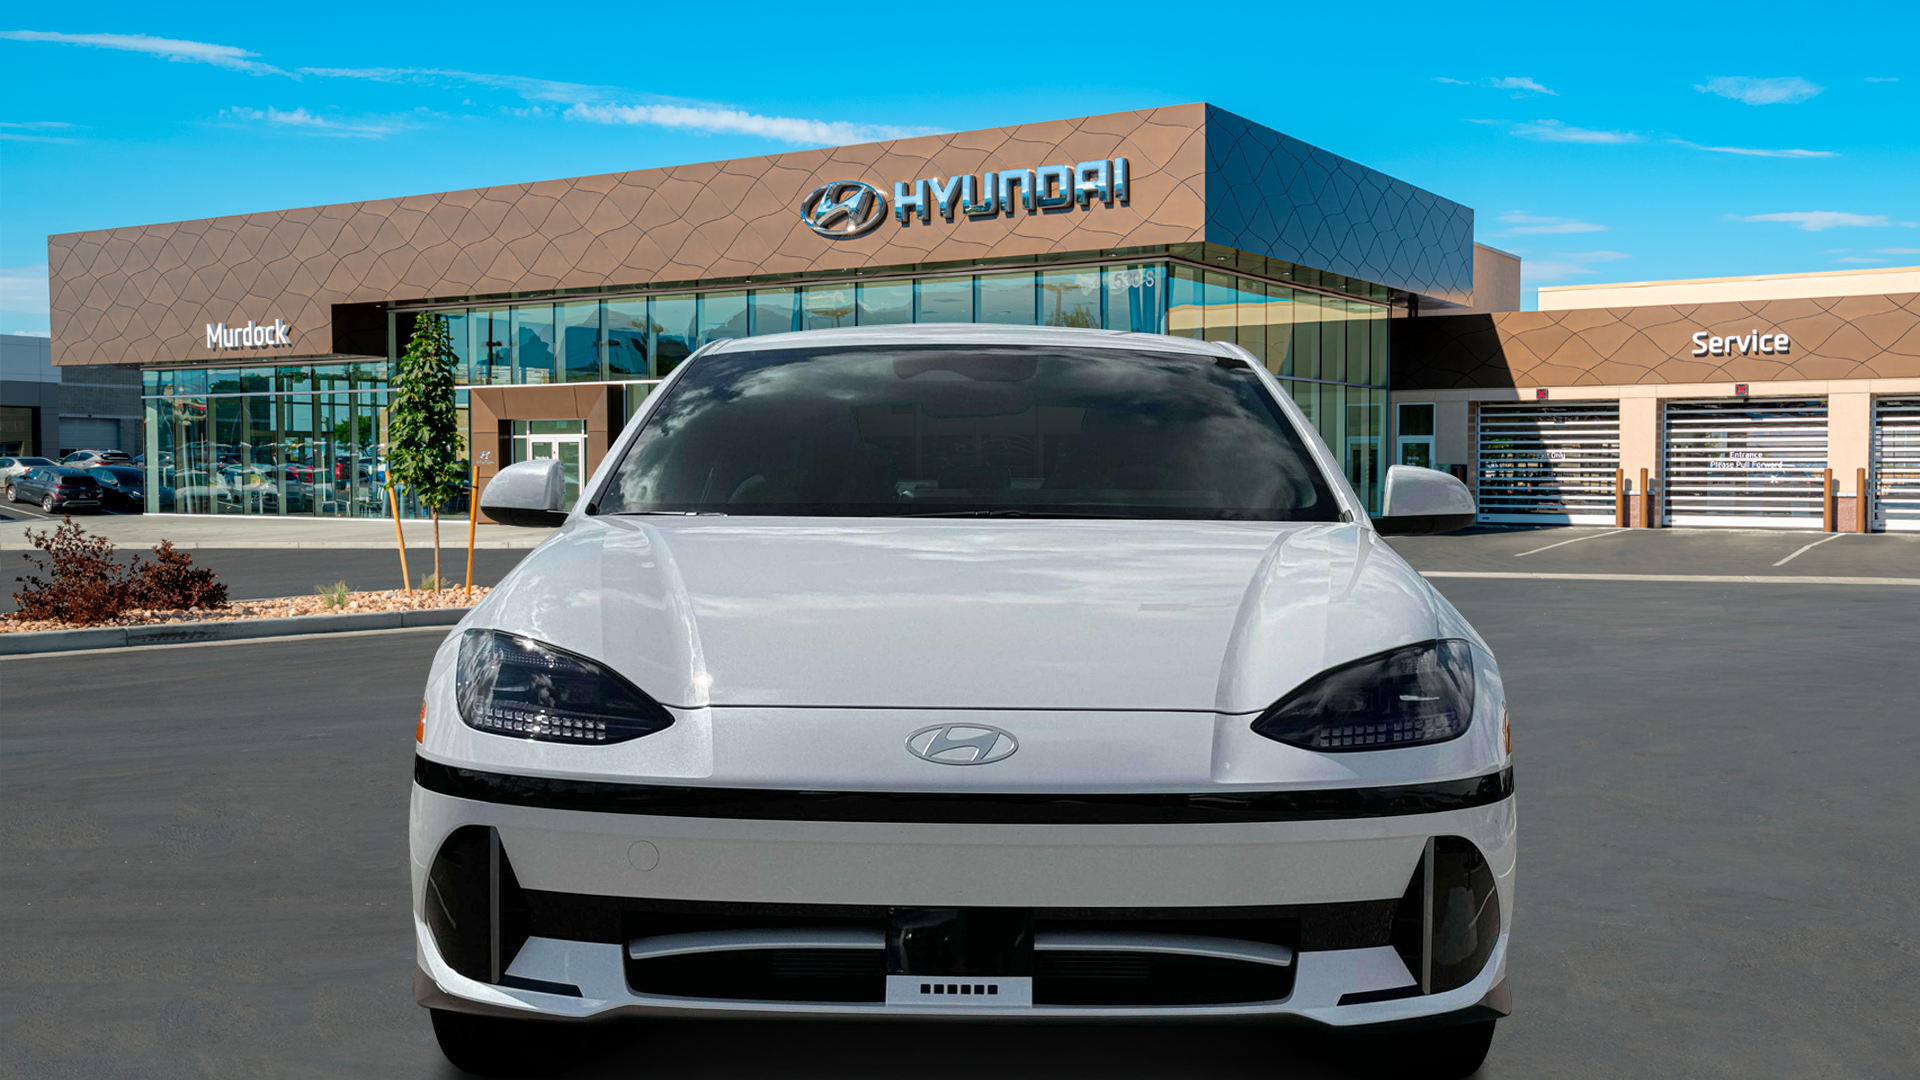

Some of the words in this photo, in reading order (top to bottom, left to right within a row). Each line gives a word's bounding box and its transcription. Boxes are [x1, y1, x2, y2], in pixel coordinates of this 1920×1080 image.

[894, 157, 1130, 223] HYUNDAI
[1114, 271, 1141, 289] 530
[1145, 270, 1155, 288] S
[206, 318, 289, 349] Murdock
[1691, 329, 1790, 355] Service
[1551, 451, 1565, 460] Only
[1729, 451, 1763, 459] Entrance
[1710, 461, 1734, 469] Please
[1735, 461, 1750, 469] Pull
[1752, 461, 1783, 469] Forward
